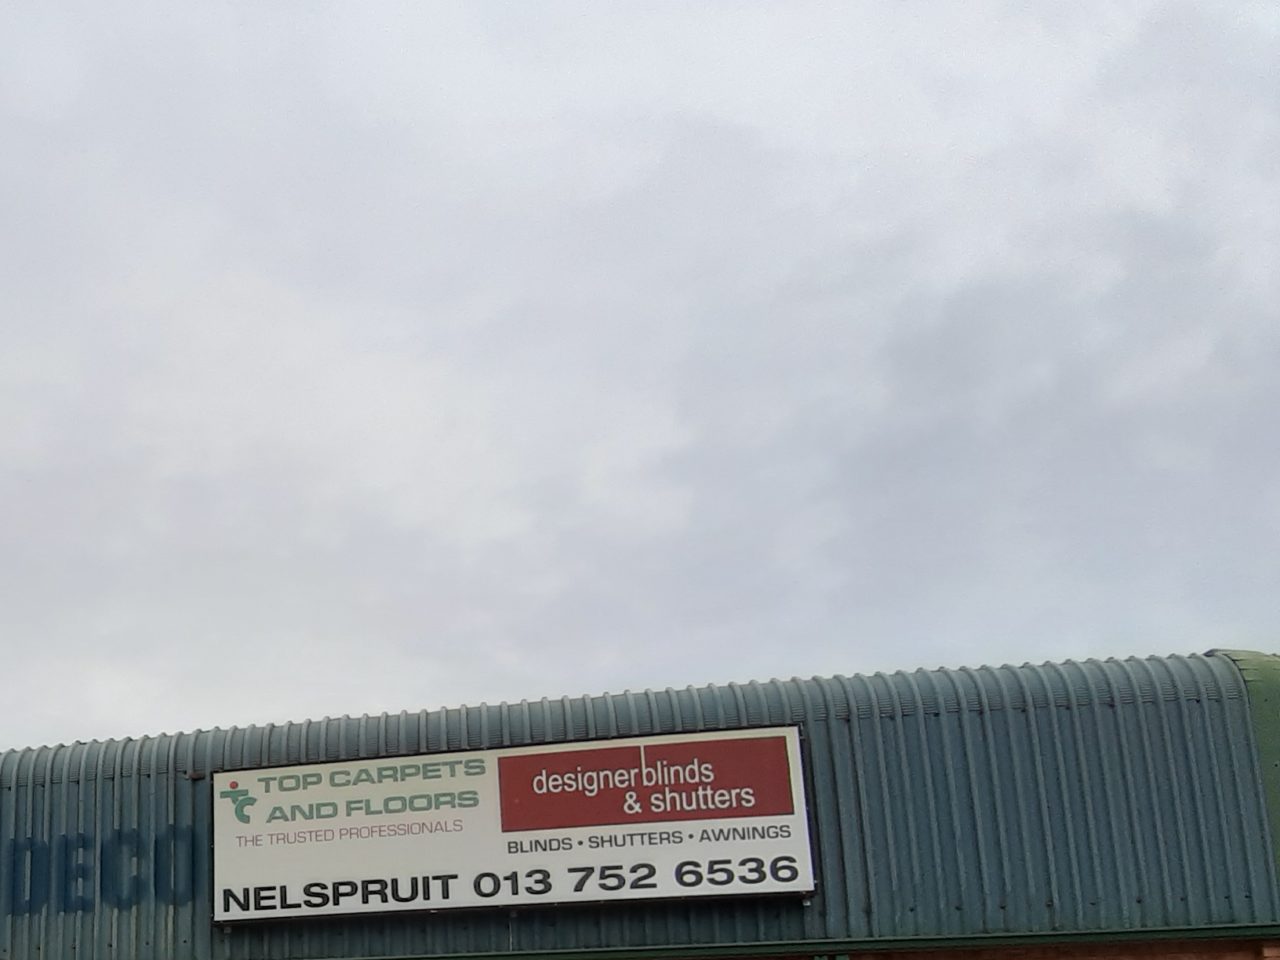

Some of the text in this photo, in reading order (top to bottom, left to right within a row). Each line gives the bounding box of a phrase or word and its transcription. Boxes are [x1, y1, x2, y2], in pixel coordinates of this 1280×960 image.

[257, 758, 486, 794] TOP CARPETS
[532, 767, 640, 797] designer
[266, 790, 480, 824] AND FLOORS
[623, 785, 756, 814] & shutters
[235, 819, 464, 848] THE TRUSTED PROFESSIONALS
[507, 825, 792, 854] BLINDS SHUTTERS AWNINGS
[222, 856, 800, 913] NELSPRUIT 013 752 6536
